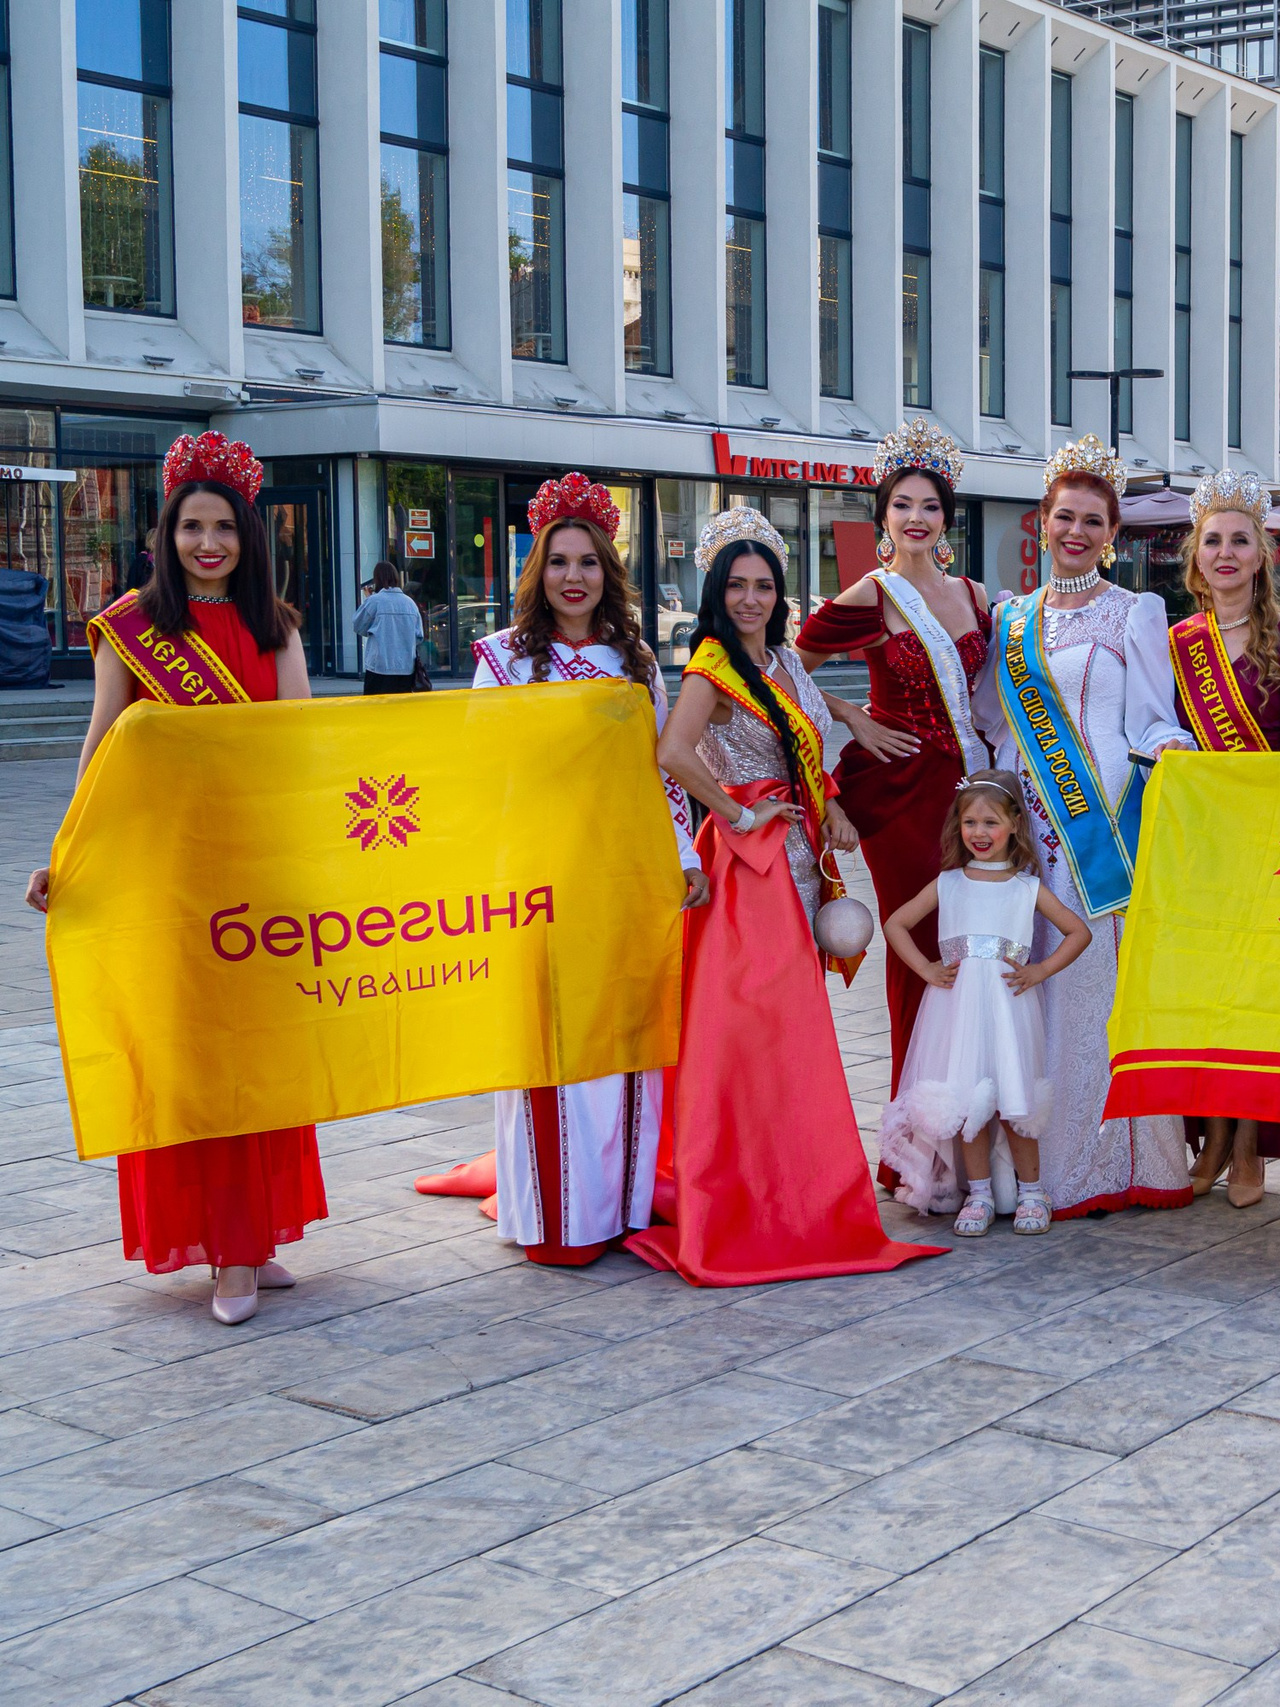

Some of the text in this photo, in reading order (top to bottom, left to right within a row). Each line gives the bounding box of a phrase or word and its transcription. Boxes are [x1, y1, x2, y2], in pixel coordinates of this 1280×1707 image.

[802, 461, 848, 483] LIVE
[136, 624, 221, 705] БЕРЕГ
[1006, 615, 1031, 688] КОРОЛЕВА
[1018, 686, 1060, 752] СПОРТА
[1188, 639, 1247, 752] БЕРЕГИНЯ
[1046, 748, 1090, 819] РОССИИ
[209, 885, 554, 967] берегиня
[296, 957, 489, 1007] чувашии
